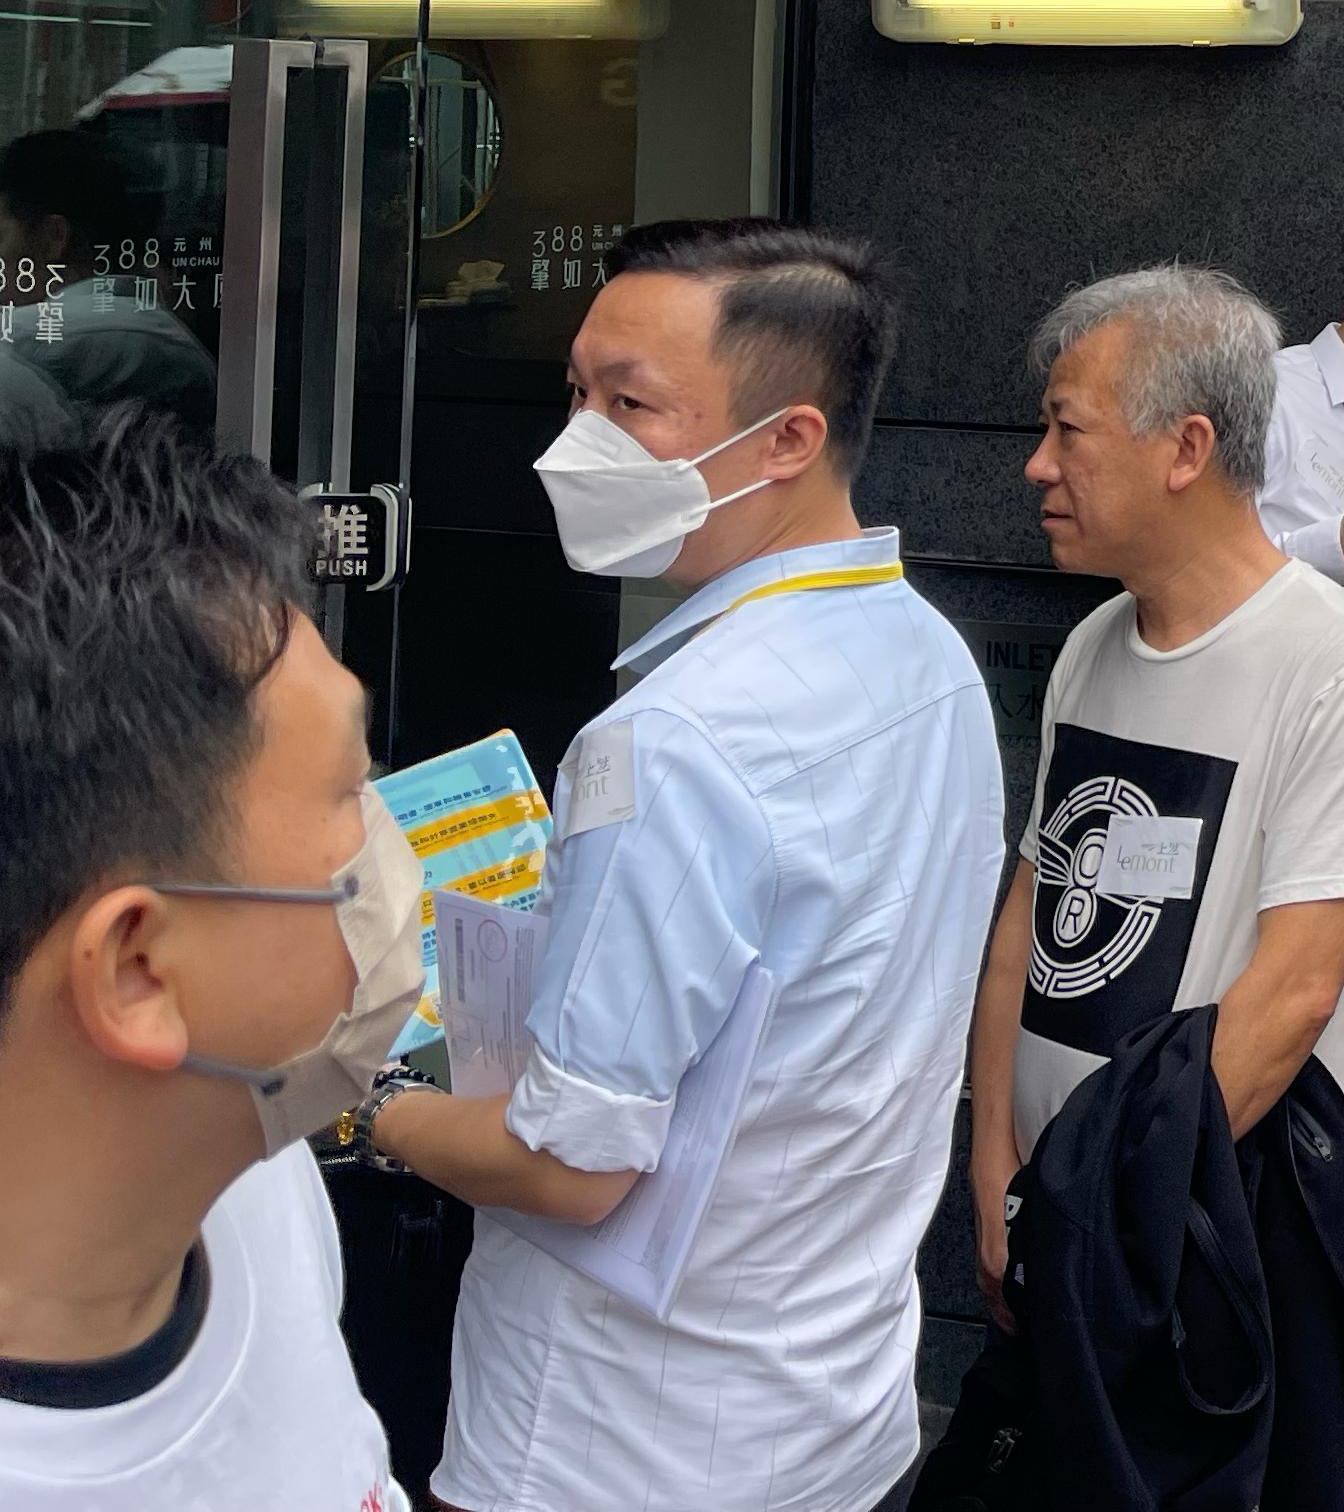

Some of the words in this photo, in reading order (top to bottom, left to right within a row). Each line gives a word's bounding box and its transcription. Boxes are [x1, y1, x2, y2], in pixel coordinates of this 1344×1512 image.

[93, 238, 160, 276] 388
[533, 225, 583, 257] 388
[318, 504, 368, 559] 推
[315, 559, 367, 576] PUSH
